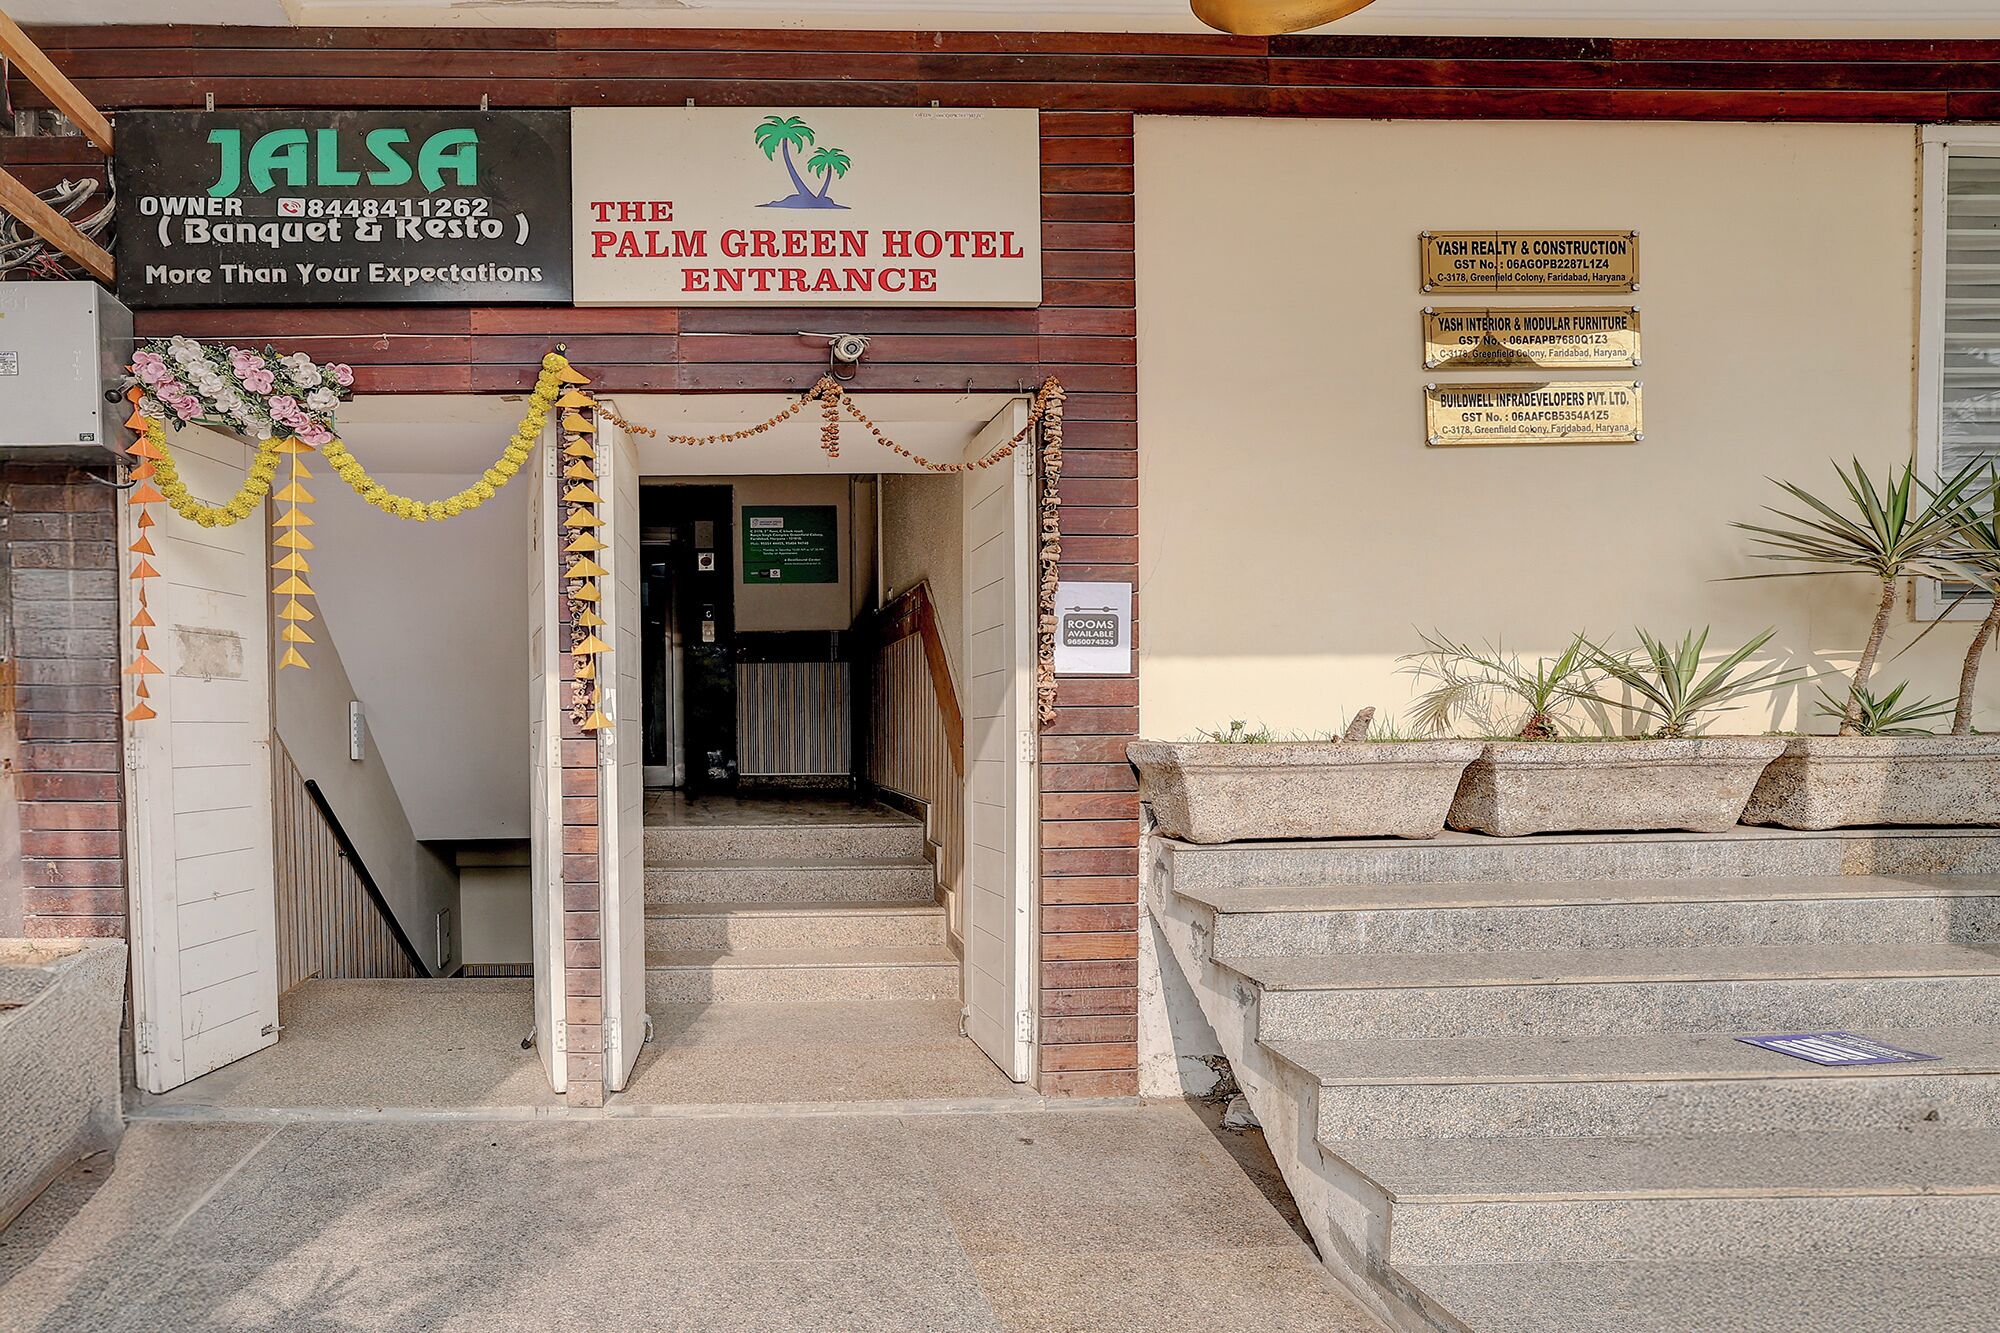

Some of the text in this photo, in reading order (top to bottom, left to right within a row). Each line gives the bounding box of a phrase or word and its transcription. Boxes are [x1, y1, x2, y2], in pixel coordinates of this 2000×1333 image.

[206, 128, 479, 198] JALSA
[139, 196, 489, 218] OWNER 8448411262
[590, 201, 673, 222] THE
[183, 217, 342, 249] Banquet
[354, 216, 383, 242] &
[395, 216, 504, 242] Resto
[591, 229, 1024, 258] PALM GREEN HOTEL
[1436, 240, 1626, 255] YASH REALTY & CONSTRUCTION
[1454, 259, 1476, 269] GST
[1479, 259, 1498, 269] No.
[145, 262, 543, 286] More Than Your Expectations
[681, 268, 937, 292] ENTRANCE
[1437, 272, 1626, 284] C-3178, Greenfield Colony, Faridabad, Haryana
[1438, 316, 1628, 332] YASH INTERIOR & MODULAR FURNITURE
[1458, 335, 1480, 345] GST
[1483, 335, 1501, 345] No.
[1472, 349, 1514, 358] Greenfield
[1516, 349, 1547, 360] Colony,
[1549, 348, 1592, 358] Faridabad,
[1594, 348, 1627, 359] Haryana
[1440, 391, 1630, 408] BUILDWELL INFRADEVELOPERS PVT. LTD.
[1461, 412, 1482, 422] GST
[1486, 412, 1503, 422] No.
[1442, 423, 1629, 435] C-3178, Greenfield Colony, Faridabad, Haryana
[1067, 620, 1114, 629] ROOMS
[1067, 630, 1114, 638] AVAILABLE
